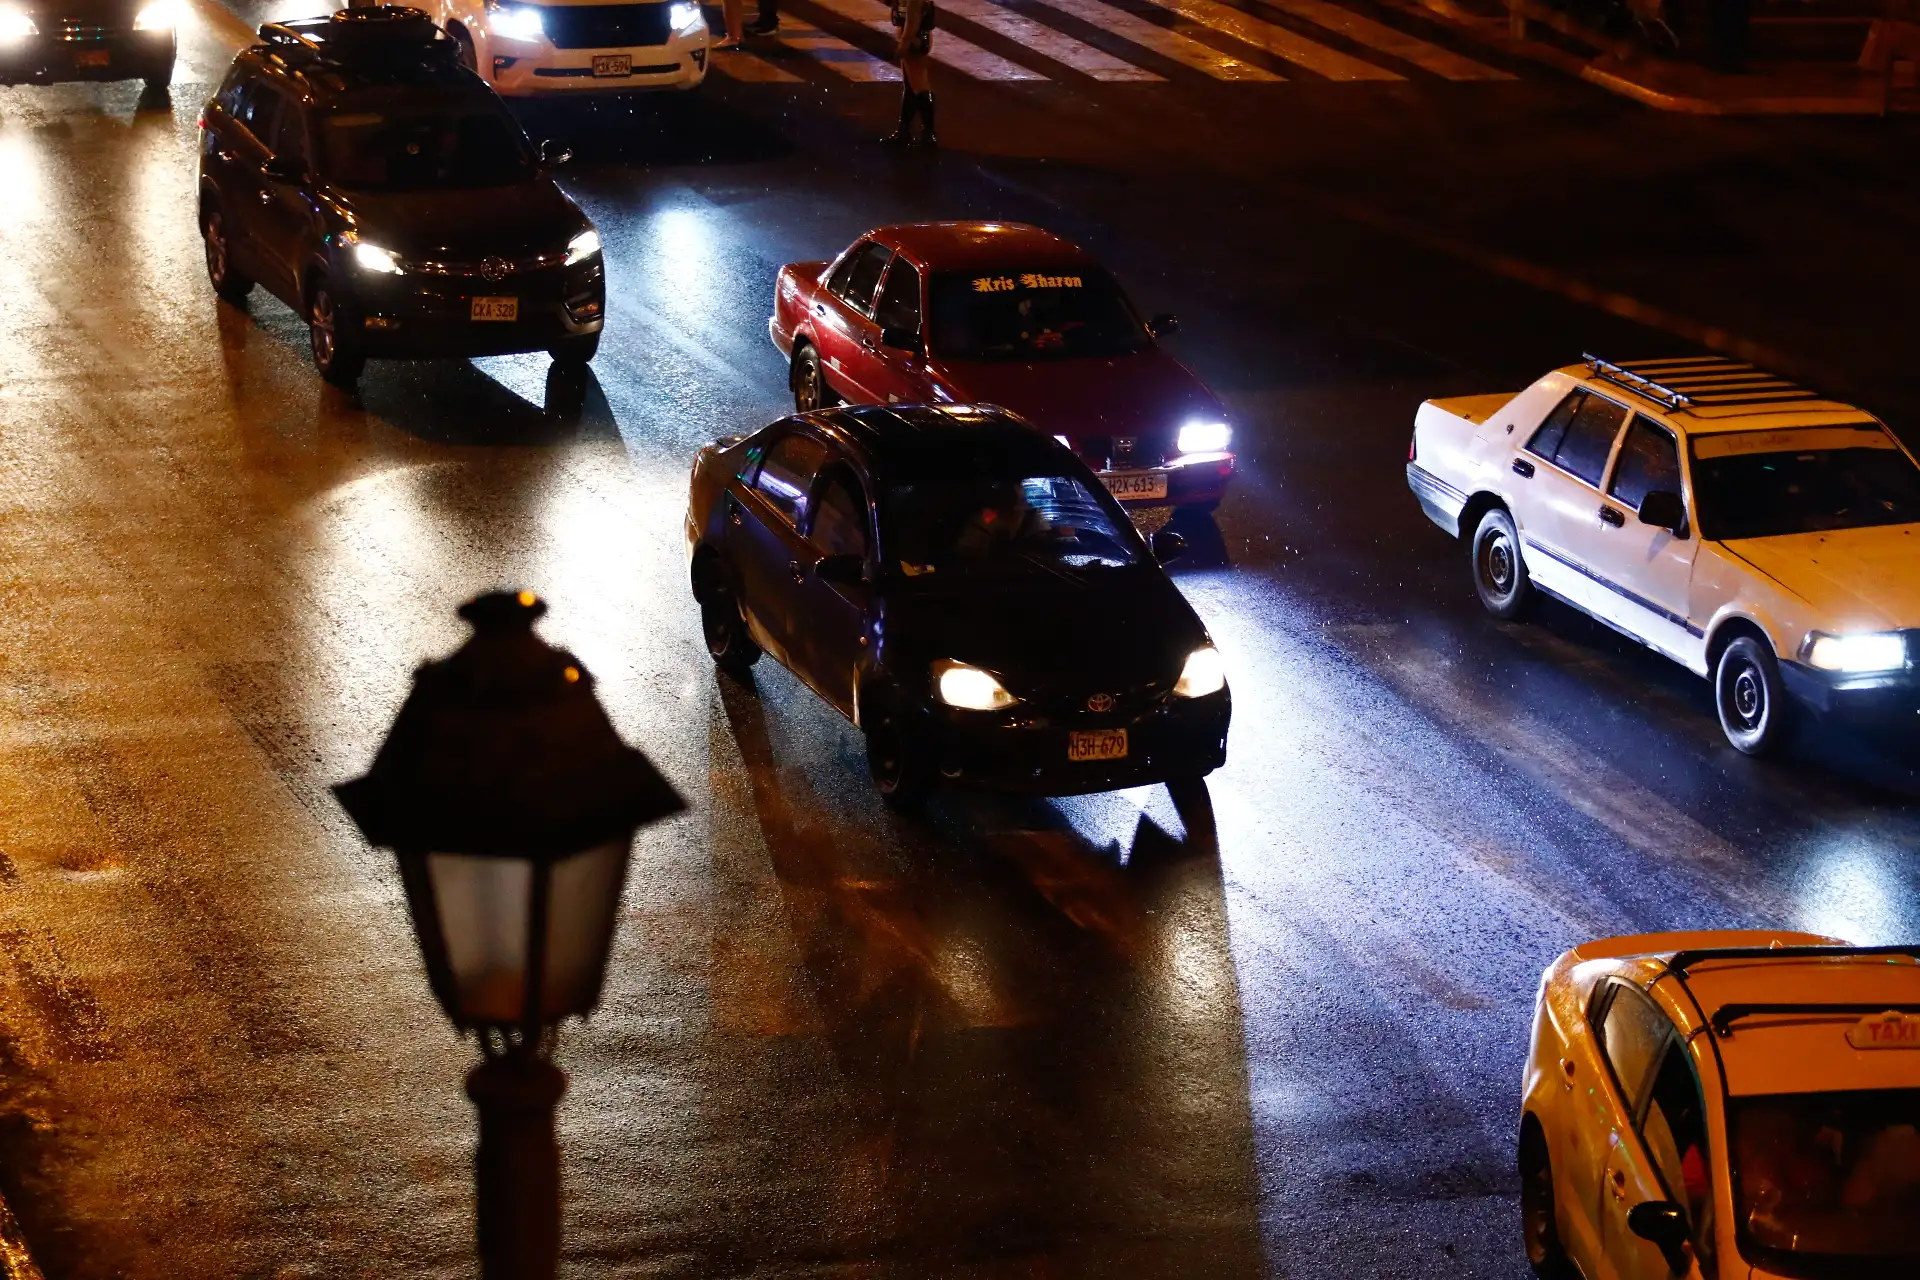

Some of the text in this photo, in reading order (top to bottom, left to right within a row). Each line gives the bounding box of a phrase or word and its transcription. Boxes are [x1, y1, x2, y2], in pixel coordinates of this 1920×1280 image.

[971, 273, 1083, 292] Kris Sharon
[1109, 476, 1154, 494] H2X-613
[1071, 736, 1124, 757] H3H-679
[1868, 1022, 1917, 1042] TAXI
